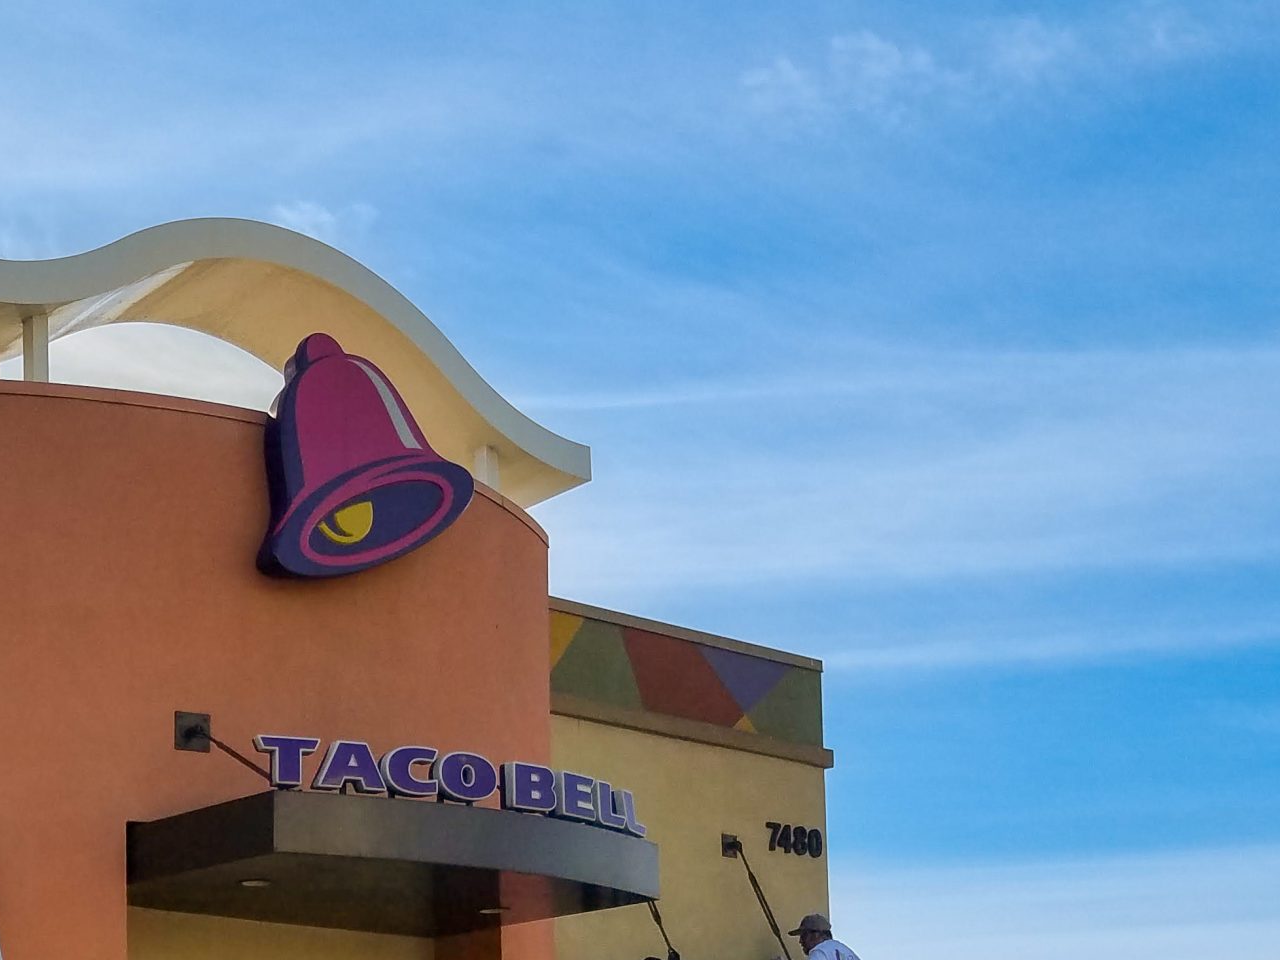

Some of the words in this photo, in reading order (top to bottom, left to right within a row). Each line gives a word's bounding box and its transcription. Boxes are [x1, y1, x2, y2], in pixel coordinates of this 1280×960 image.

[253, 734, 497, 801] TACO
[504, 761, 647, 838] BELL
[765, 821, 822, 858] 7480
